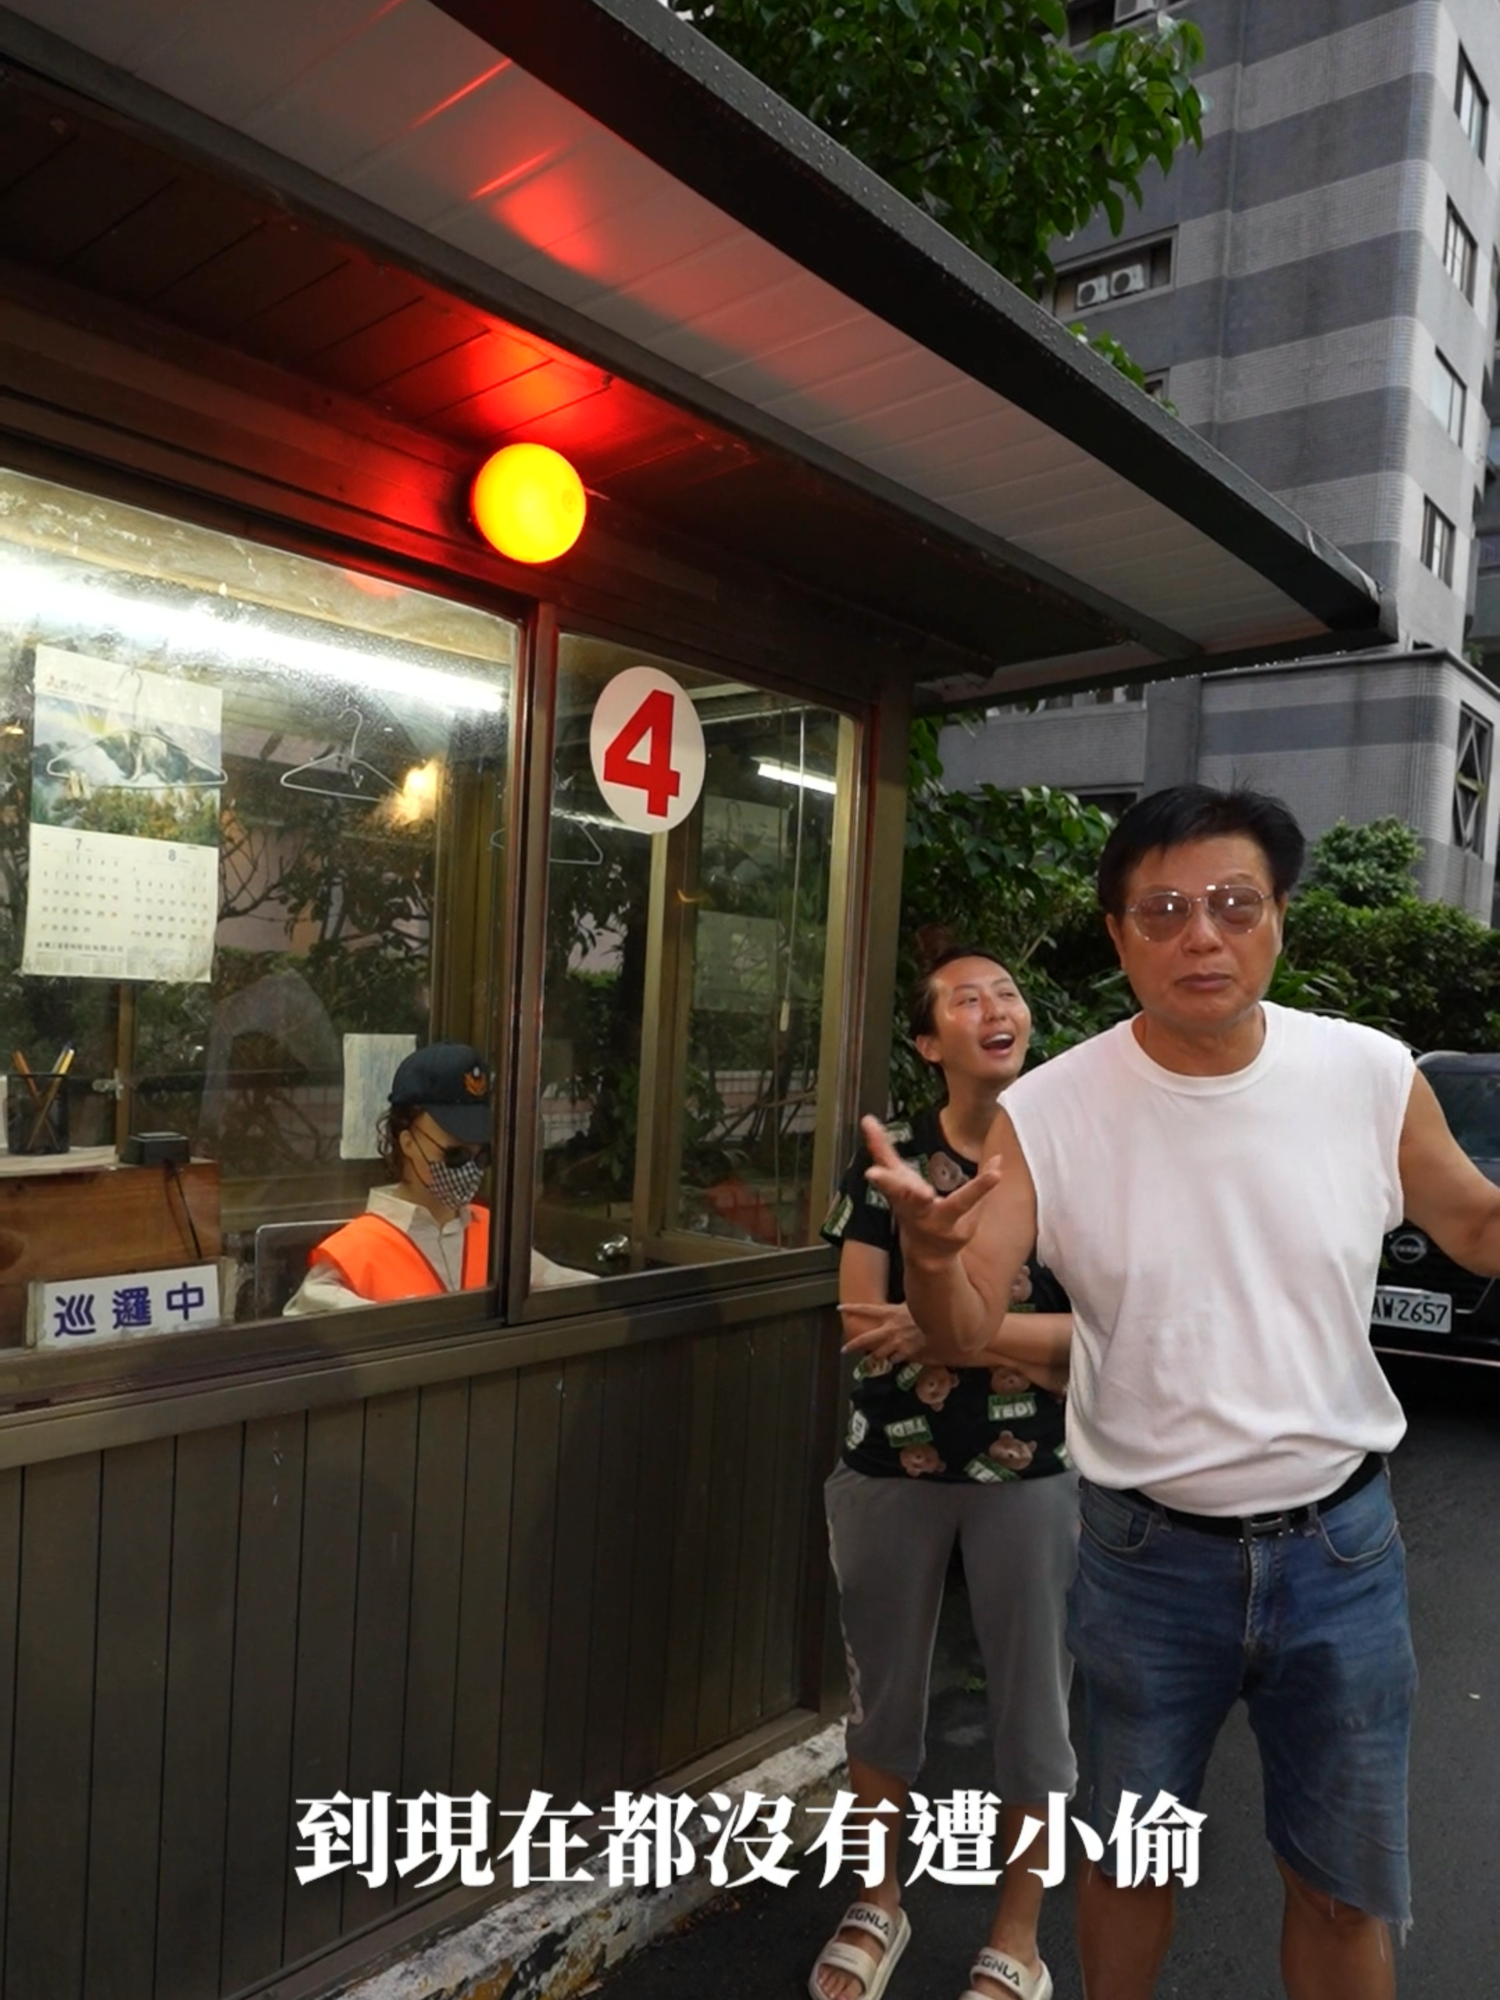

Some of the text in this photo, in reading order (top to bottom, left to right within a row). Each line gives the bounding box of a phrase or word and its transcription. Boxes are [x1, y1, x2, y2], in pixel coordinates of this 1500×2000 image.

[603, 688, 681, 818] 4
[53, 1281, 204, 1338] 巡邏中
